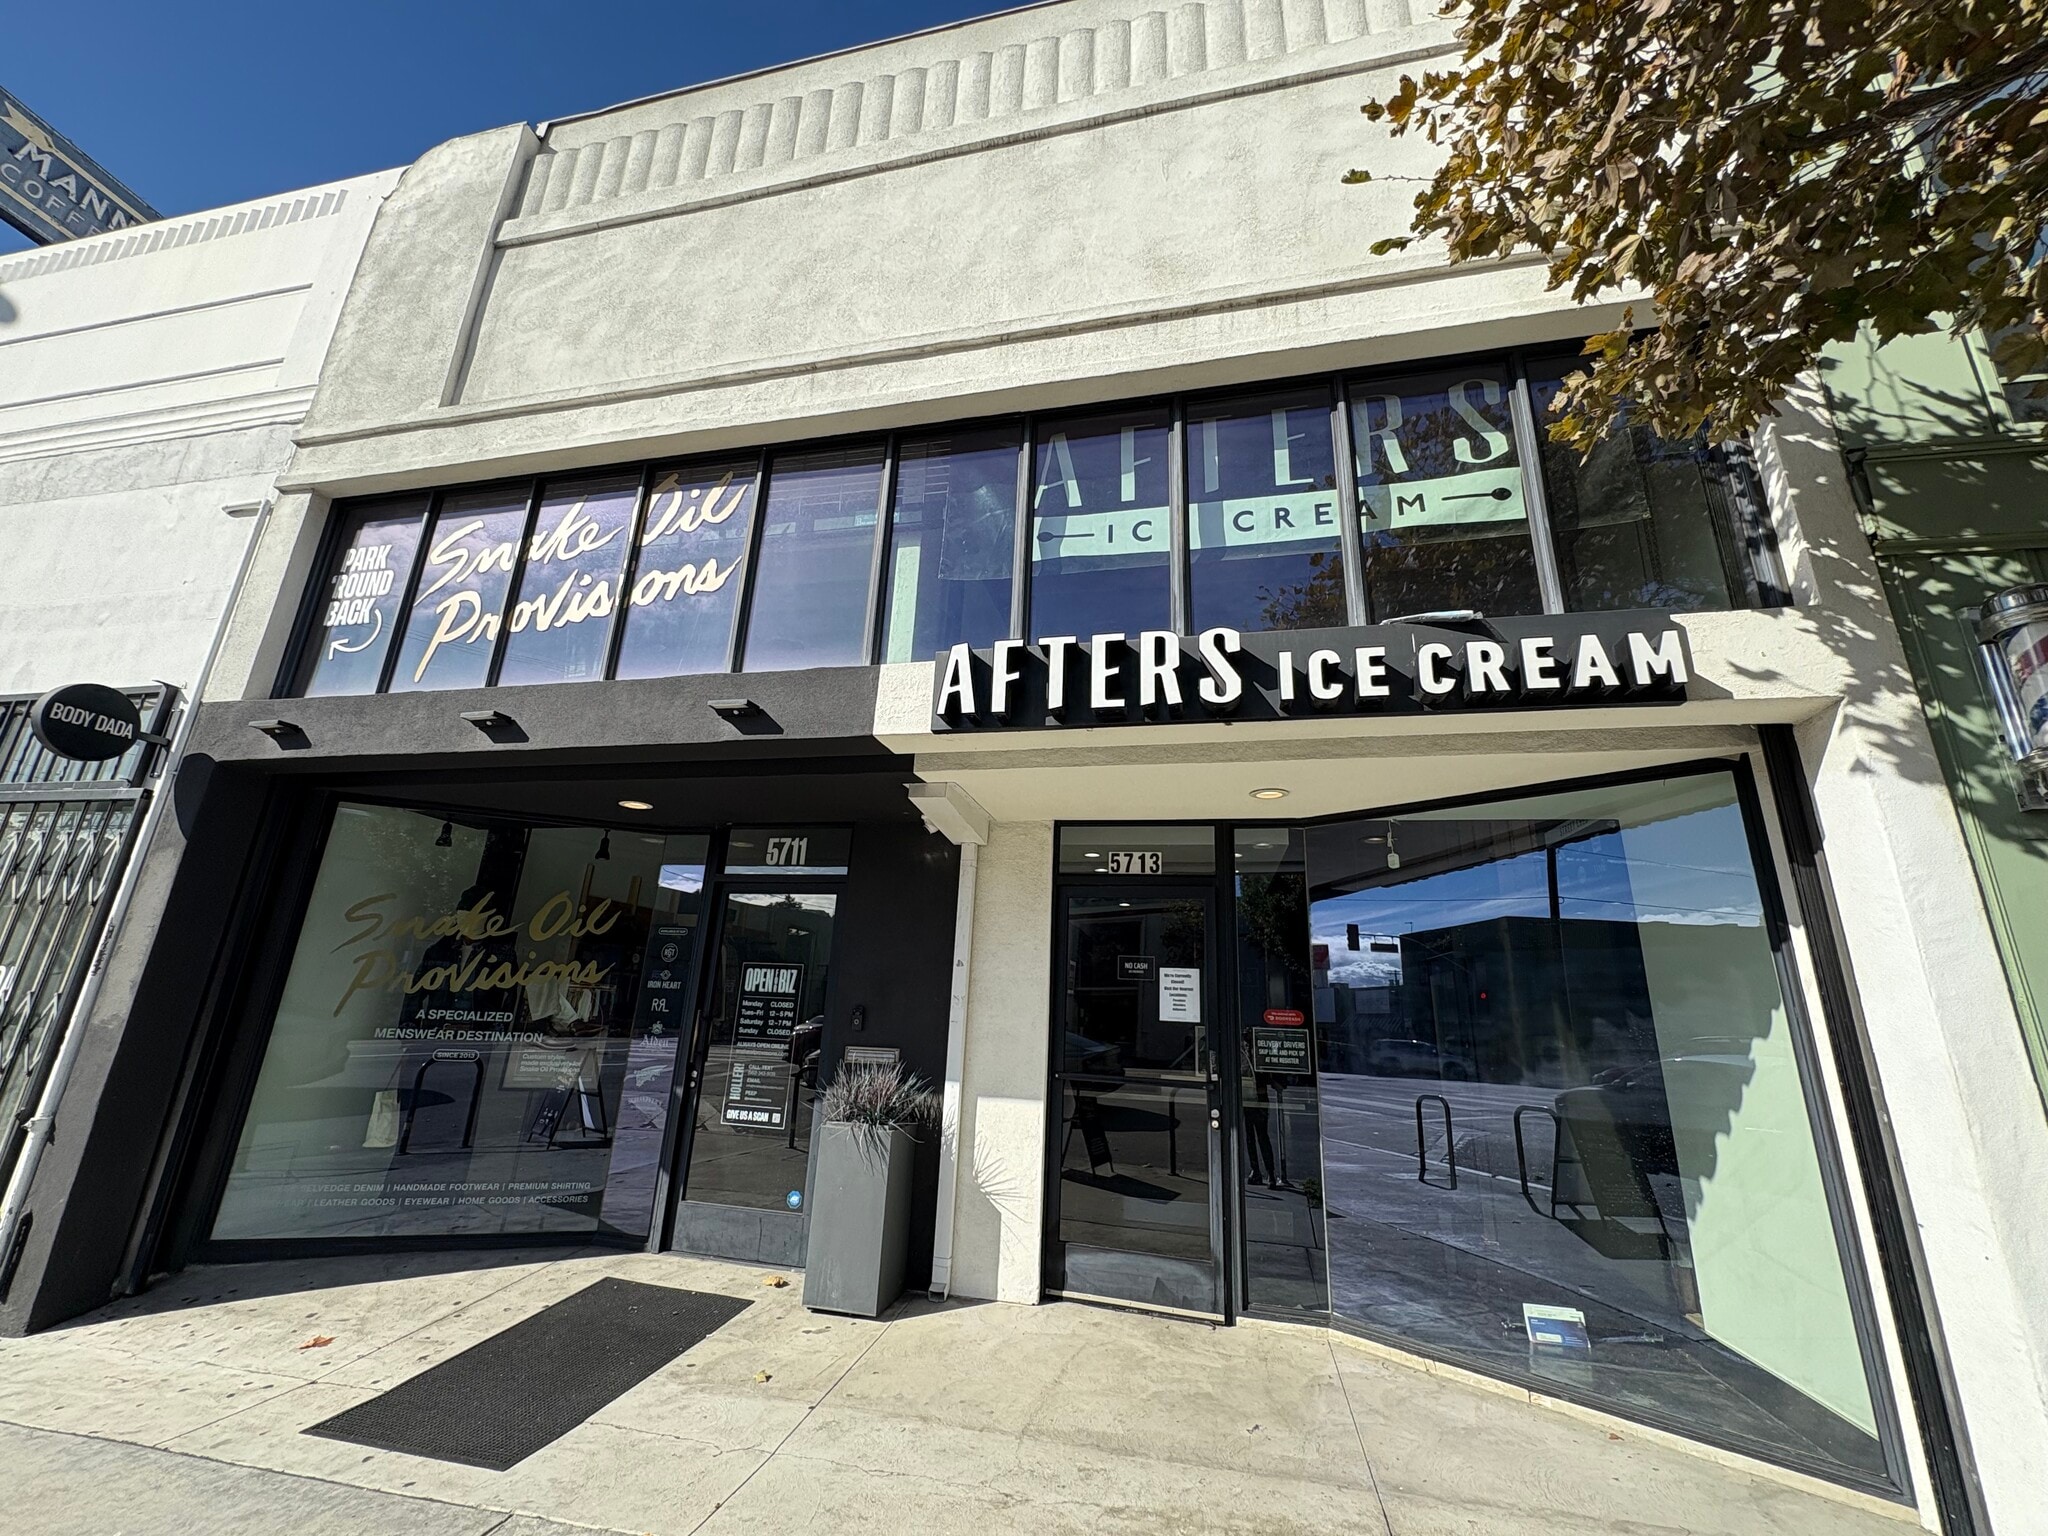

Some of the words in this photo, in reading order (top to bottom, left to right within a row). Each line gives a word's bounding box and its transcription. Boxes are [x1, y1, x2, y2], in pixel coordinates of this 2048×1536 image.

[1035, 379, 1509, 510] AFTERS
[1233, 493, 1427, 533] CREAM
[414, 495, 624, 606] Snake
[628, 472, 748, 547] Oil
[340, 544, 393, 573] PARK
[323, 597, 377, 627] BACK
[414, 555, 742, 682] Provisions
[936, 627, 1242, 716] AFTERS
[1278, 646, 1391, 701] ICE
[1417, 629, 1690, 696] CREAM
[49, 702, 96, 729] BODY
[94, 715, 134, 740] DADA
[765, 837, 808, 866] 5711
[1110, 853, 1160, 873] 5713
[330, 890, 525, 953] Snake
[528, 890, 622, 942] Oil
[1124, 962, 1133, 970] NO
[1133, 962, 1148, 970] CASH
[333, 949, 616, 1018] Provisions
[647, 981, 660, 989] IRON
[661, 981, 682, 990] HEART
[744, 967, 775, 993] OPEN
[778, 969, 798, 993] BIZ
[415, 1008, 426, 1021] A
[427, 1008, 514, 1023] SPECIALIZED
[742, 1000, 764, 1008] Monday
[770, 1001, 794, 1009] CLOSED
[738, 1027, 759, 1035] Sunday
[767, 1028, 791, 1036] CLOSED
[739, 1018, 764, 1026] Saturday
[374, 1027, 455, 1041] MENSWEAR
[456, 1029, 543, 1044] DESTINATION
[1257, 1040, 1282, 1048] DELIVERY
[1283, 1041, 1306, 1049] DRIVERS
[1279, 1057, 1300, 1065] REGISTER
[729, 1062, 745, 1101] HOLLER!
[726, 1109, 740, 1120] GIVE
[739, 1110, 748, 1120] US
[752, 1111, 769, 1122] SCAN
[353, 1184, 384, 1192] DENIM
[393, 1183, 446, 1192] HANDMADE
[449, 1183, 500, 1191] FOOTWEAR
[507, 1182, 549, 1190] PREMIUM
[551, 1182, 591, 1190] SHIRTING
[314, 1198, 357, 1207] LEATHER
[361, 1198, 396, 1206] GOODS
[404, 1197, 450, 1205] EYEWEAR
[458, 1197, 487, 1205] HOME
[488, 1196, 520, 1205] GOODS
[528, 1195, 589, 1204] ACCESSORIES
